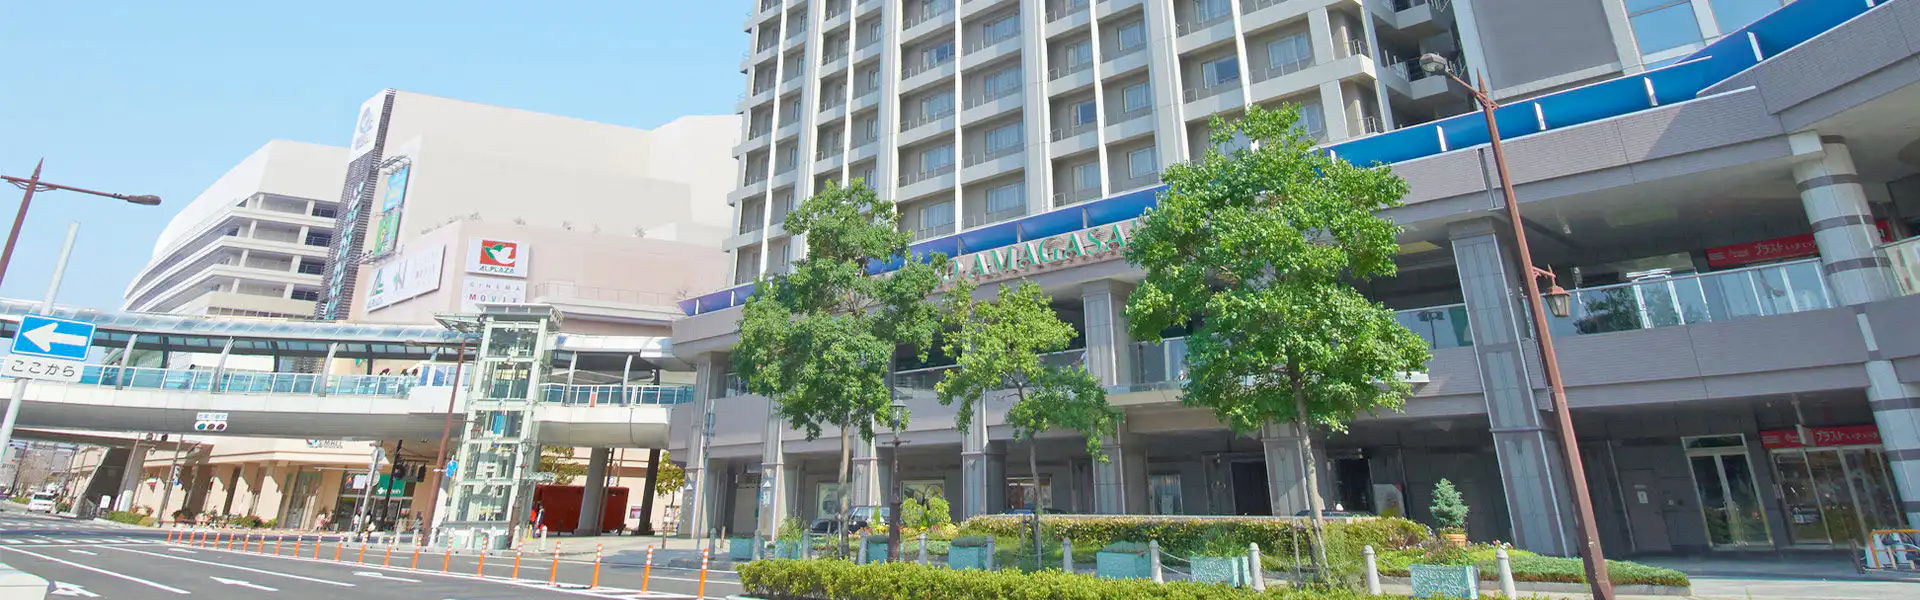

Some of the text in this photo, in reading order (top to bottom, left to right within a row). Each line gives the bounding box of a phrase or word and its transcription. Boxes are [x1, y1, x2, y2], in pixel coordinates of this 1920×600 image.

[968, 220, 1136, 280] AMAGASA
[11, 360, 75, 377] ここから
